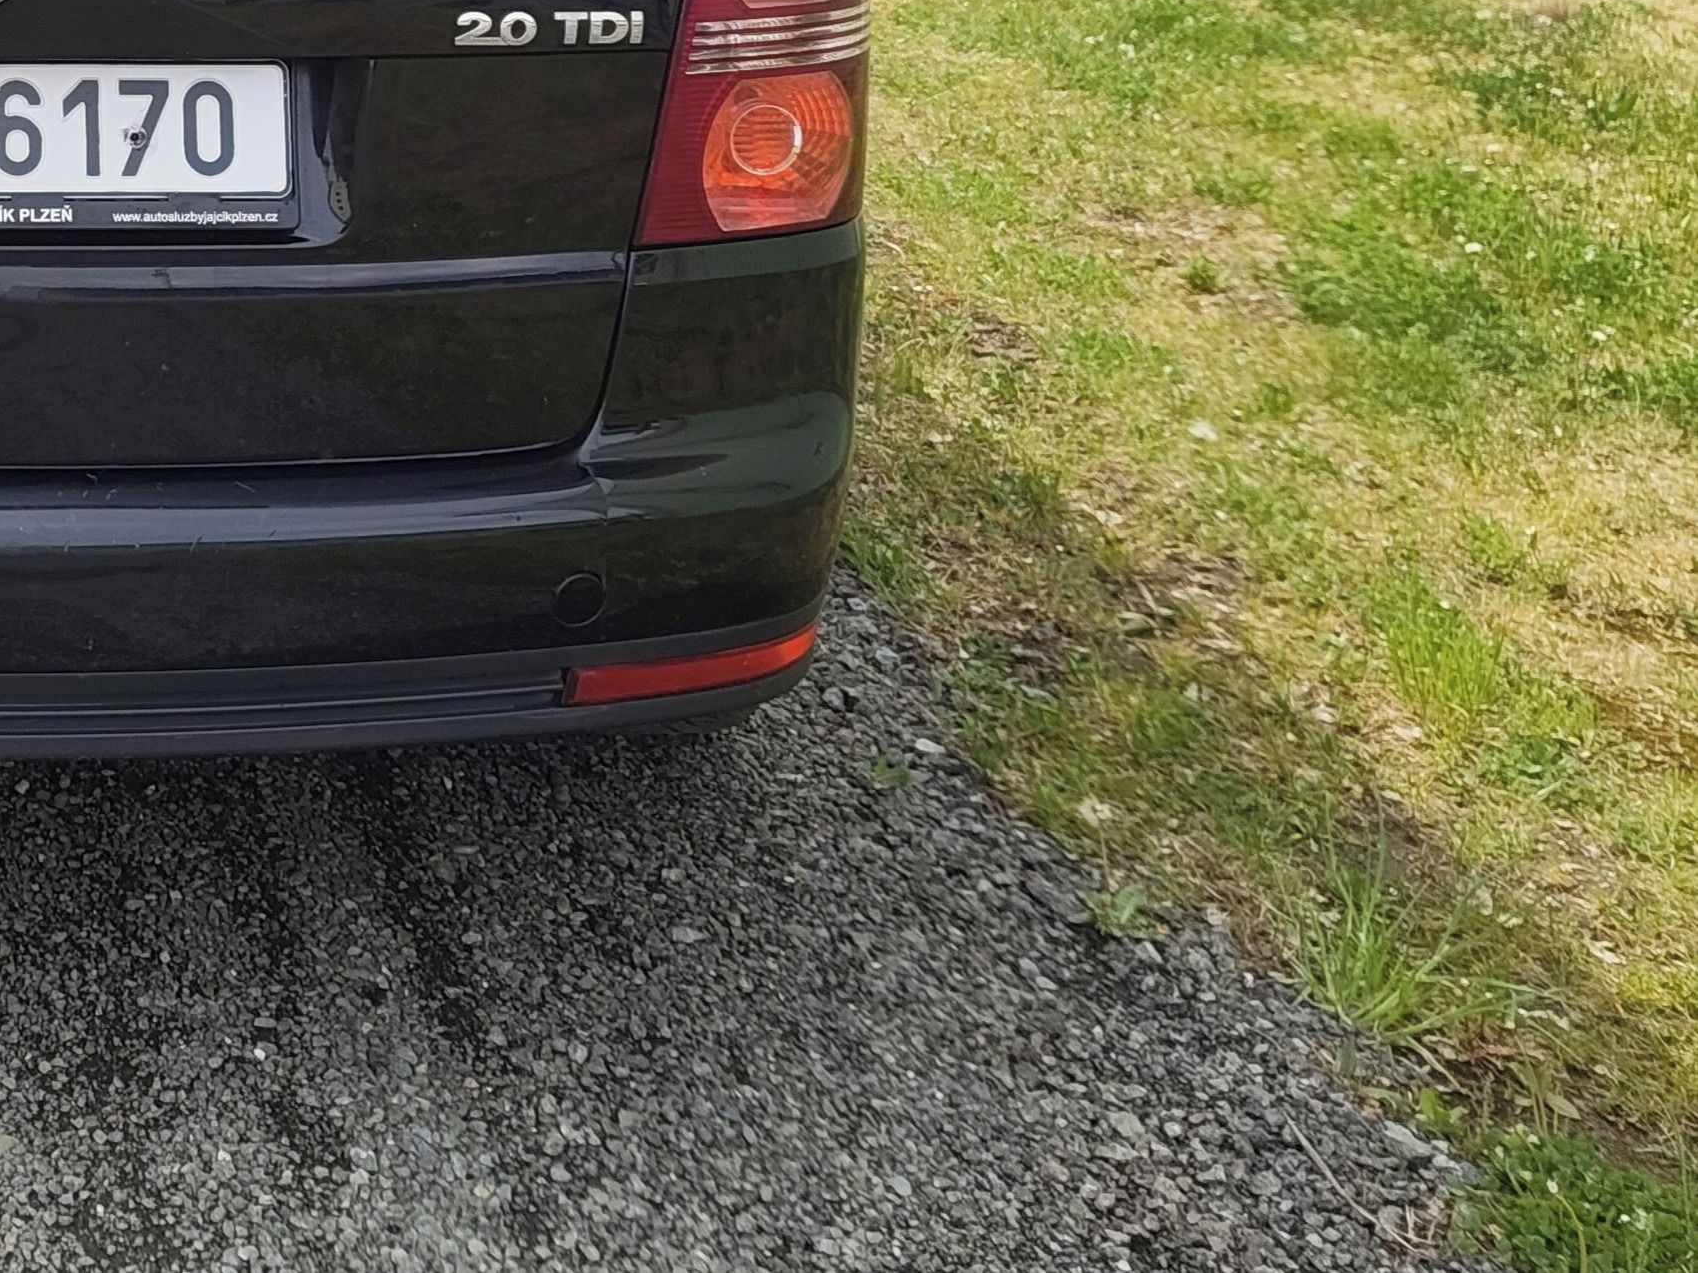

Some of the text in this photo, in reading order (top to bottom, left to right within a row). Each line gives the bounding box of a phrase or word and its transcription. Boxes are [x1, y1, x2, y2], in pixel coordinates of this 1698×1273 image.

[553, 10, 644, 45] TDI
[18, 204, 74, 223] PLZEŇ
[112, 210, 279, 225] www.autosluzbyjajcikplzen.cz
